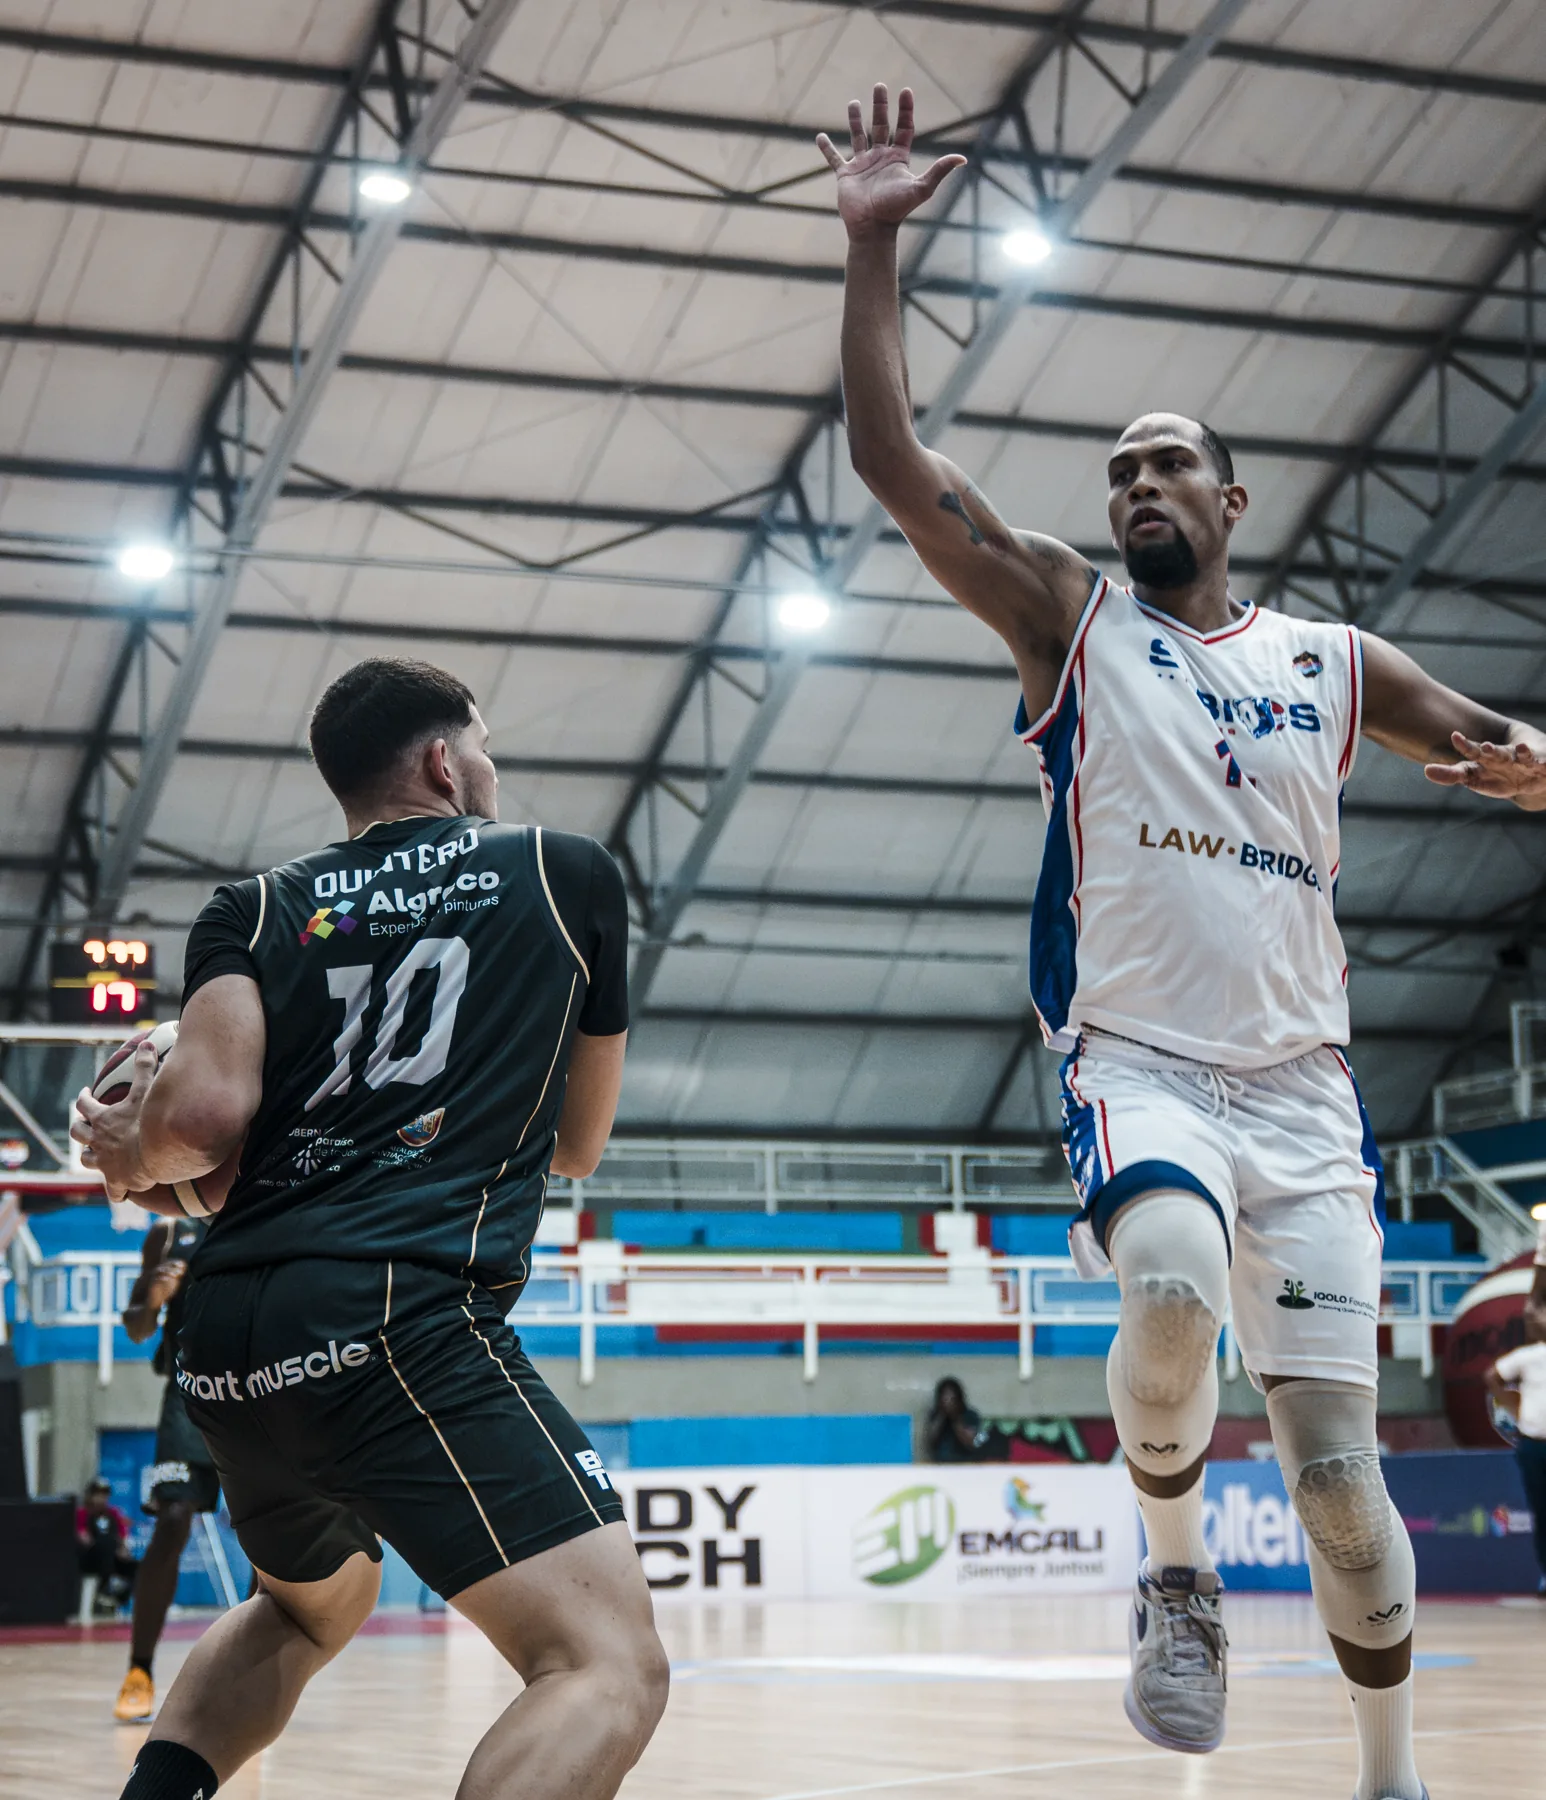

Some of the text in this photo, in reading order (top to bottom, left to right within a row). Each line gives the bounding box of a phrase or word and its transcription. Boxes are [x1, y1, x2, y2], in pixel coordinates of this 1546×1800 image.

[444, 895, 500, 915] pinturas
[93, 981, 136, 1012] 17
[305, 935, 471, 1112] 10
[1313, 1291, 1347, 1303] IQOLO
[246, 1339, 371, 1399] muscle
[635, 1486, 757, 1532] DY
[1202, 1484, 1308, 1567] olte
[635, 1539, 762, 1589] CH
[959, 1528, 1104, 1556] EMCALI
